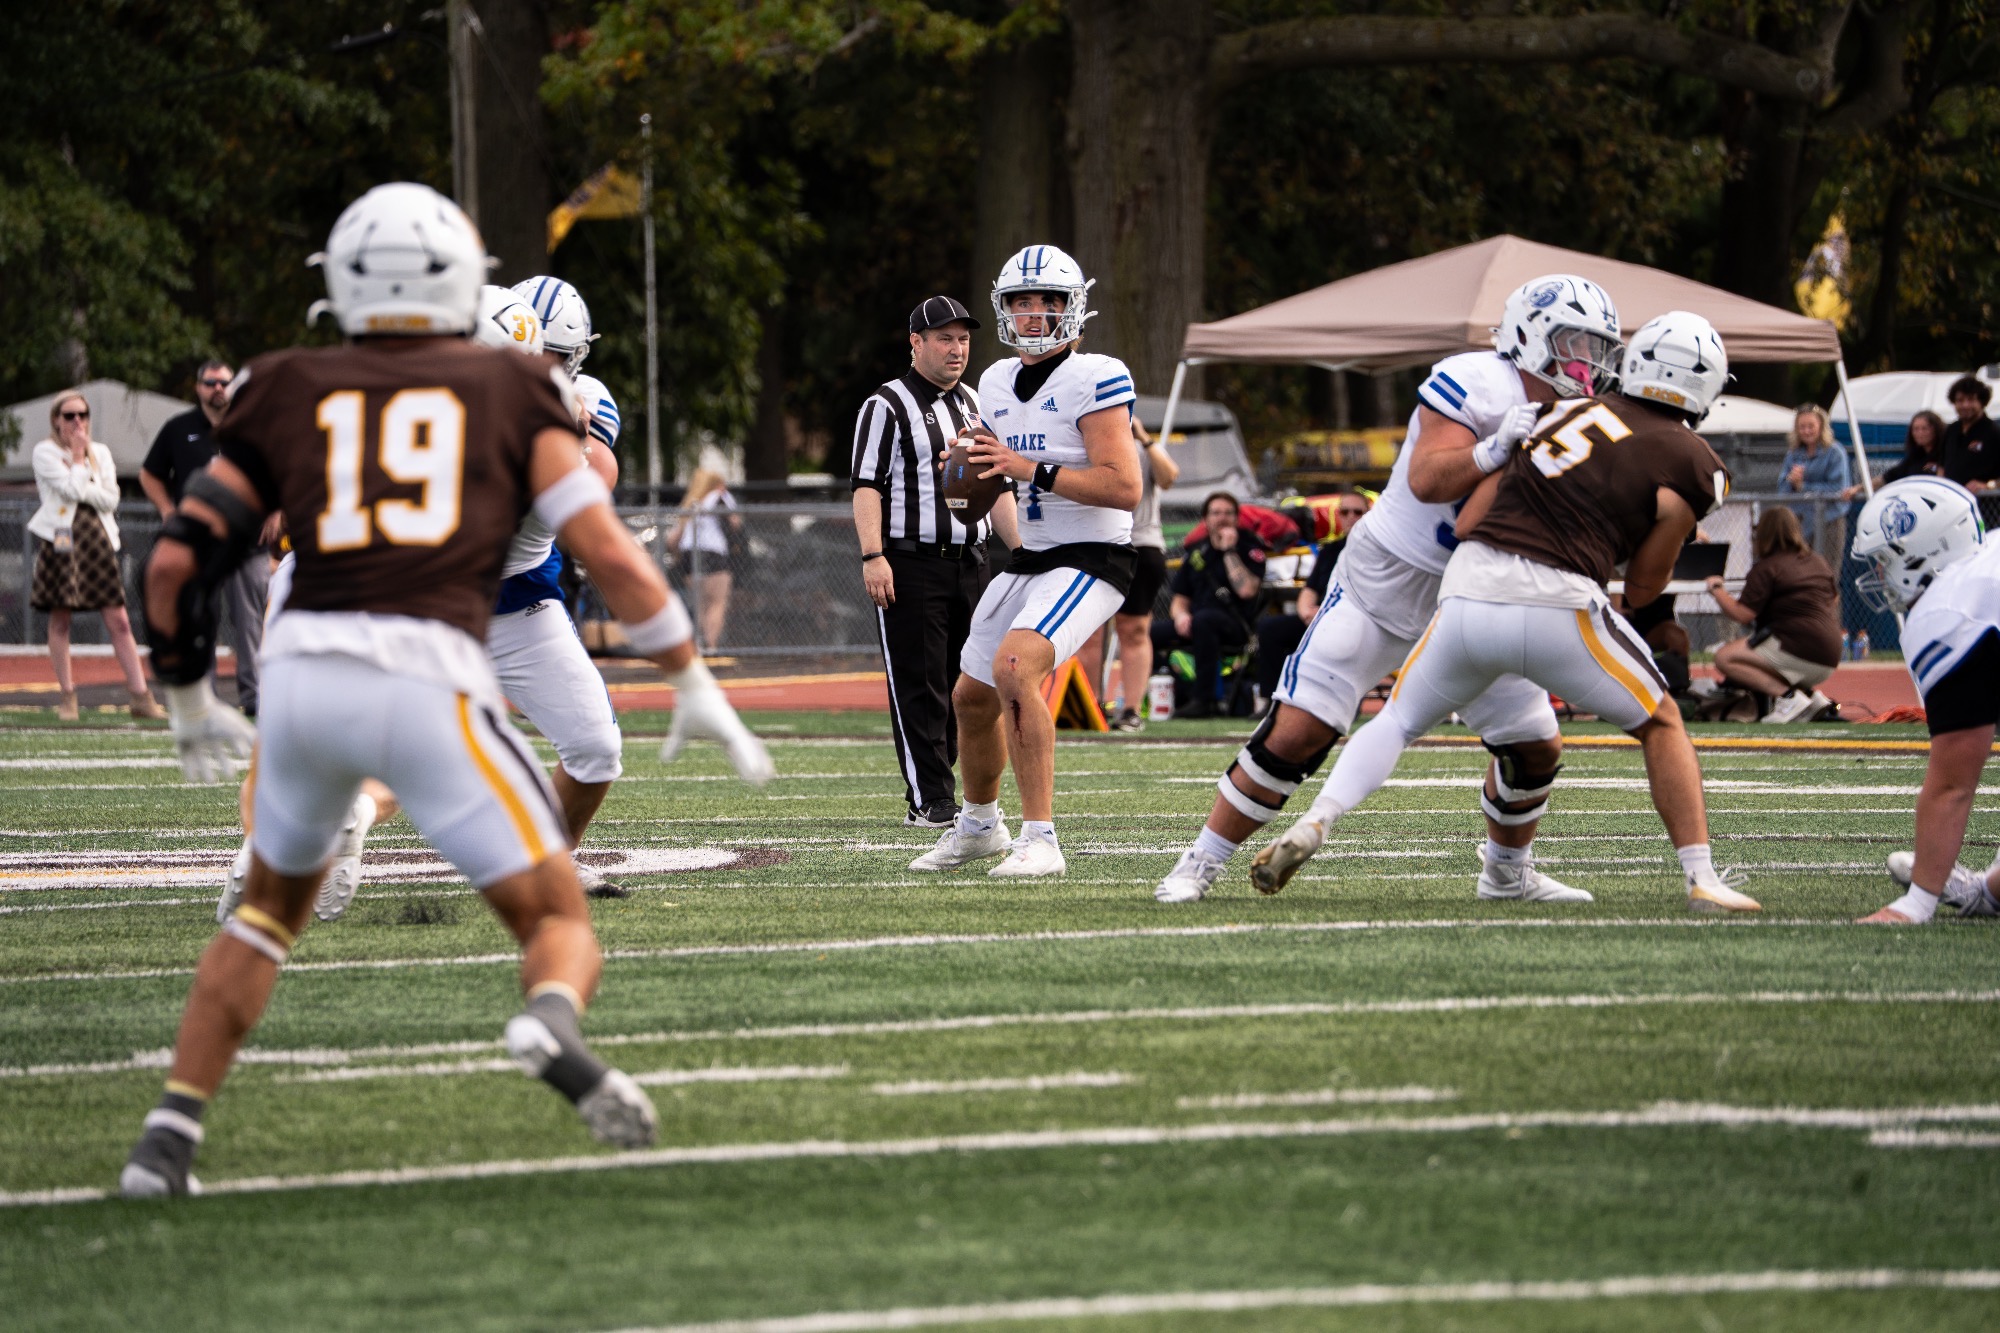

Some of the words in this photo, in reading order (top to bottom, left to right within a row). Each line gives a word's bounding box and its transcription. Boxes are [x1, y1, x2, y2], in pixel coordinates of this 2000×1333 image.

[512, 313, 537, 345] 37
[1006, 433, 1046, 452] DRAKE
[1521, 397, 1633, 479] 15
[315, 386, 467, 553] 19
